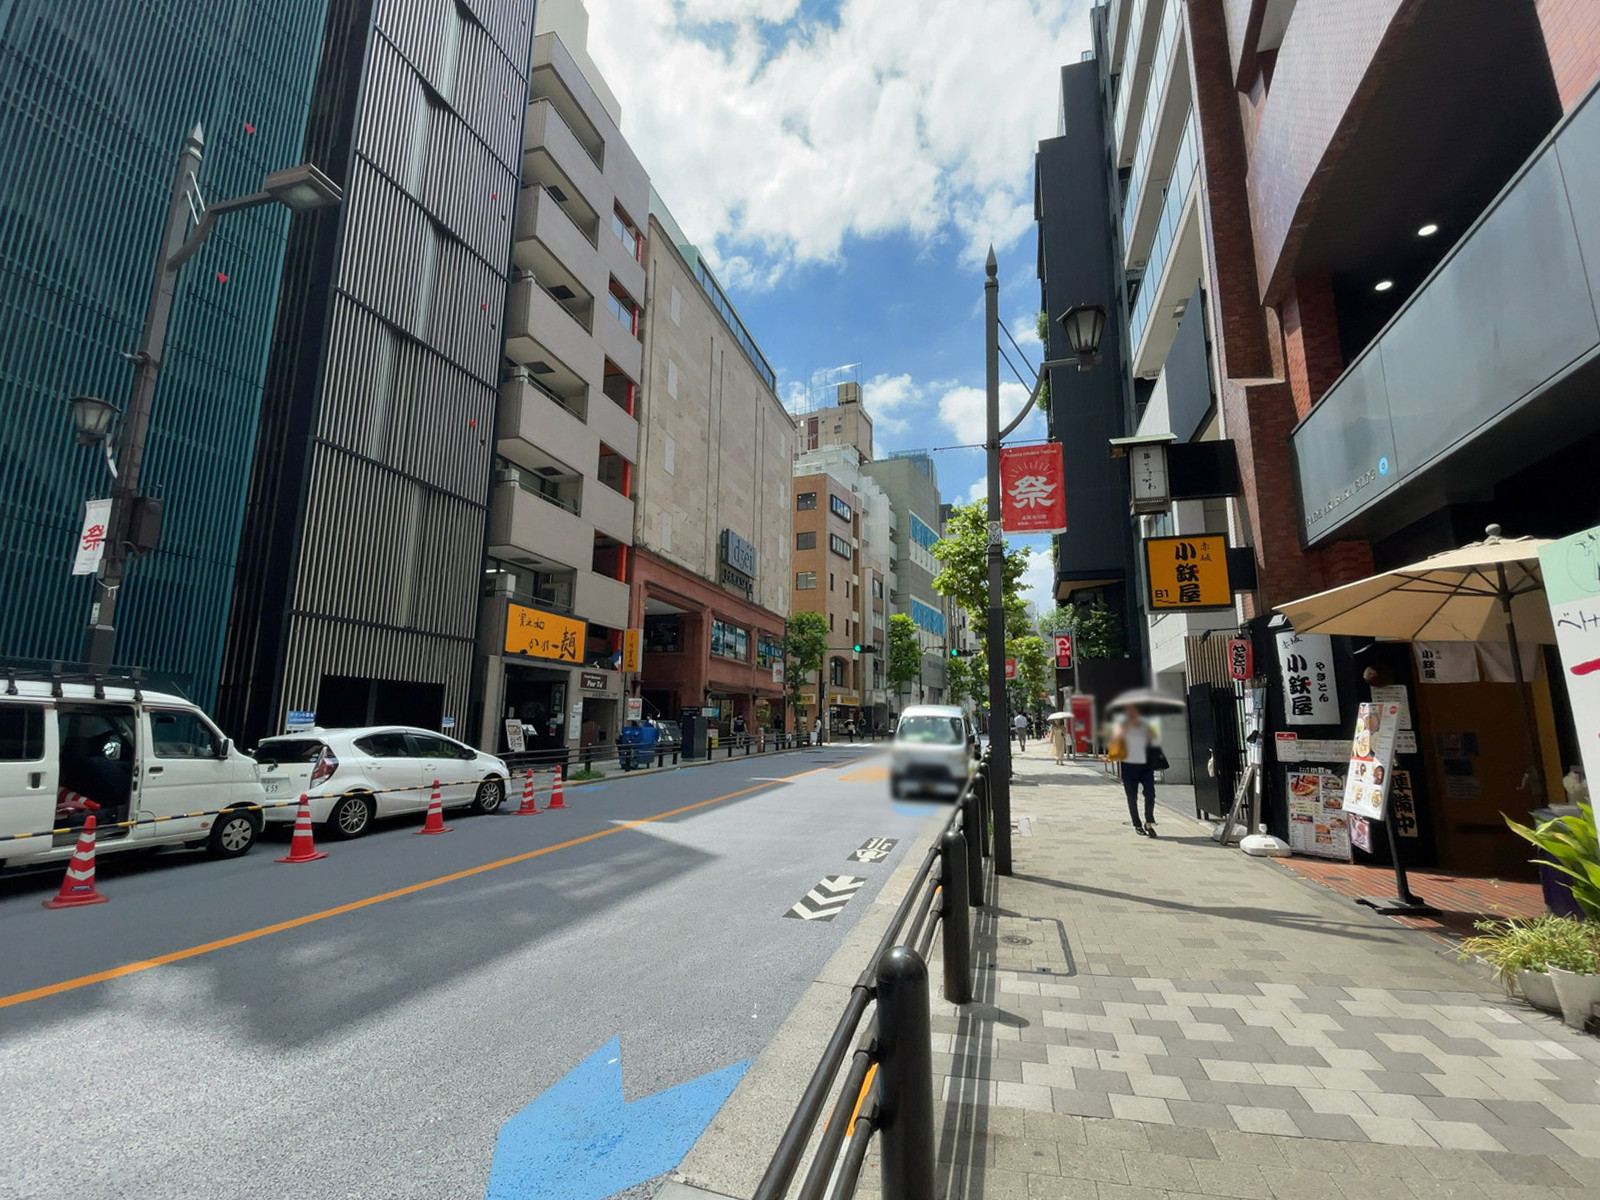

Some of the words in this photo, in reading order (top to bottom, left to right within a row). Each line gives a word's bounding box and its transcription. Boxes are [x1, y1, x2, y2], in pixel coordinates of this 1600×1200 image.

[1007, 475, 1058, 509] 祭
[82, 524, 106, 551] 祭
[1200, 541, 1212, 562] 赤坂
[1155, 589, 1169, 599] B1
